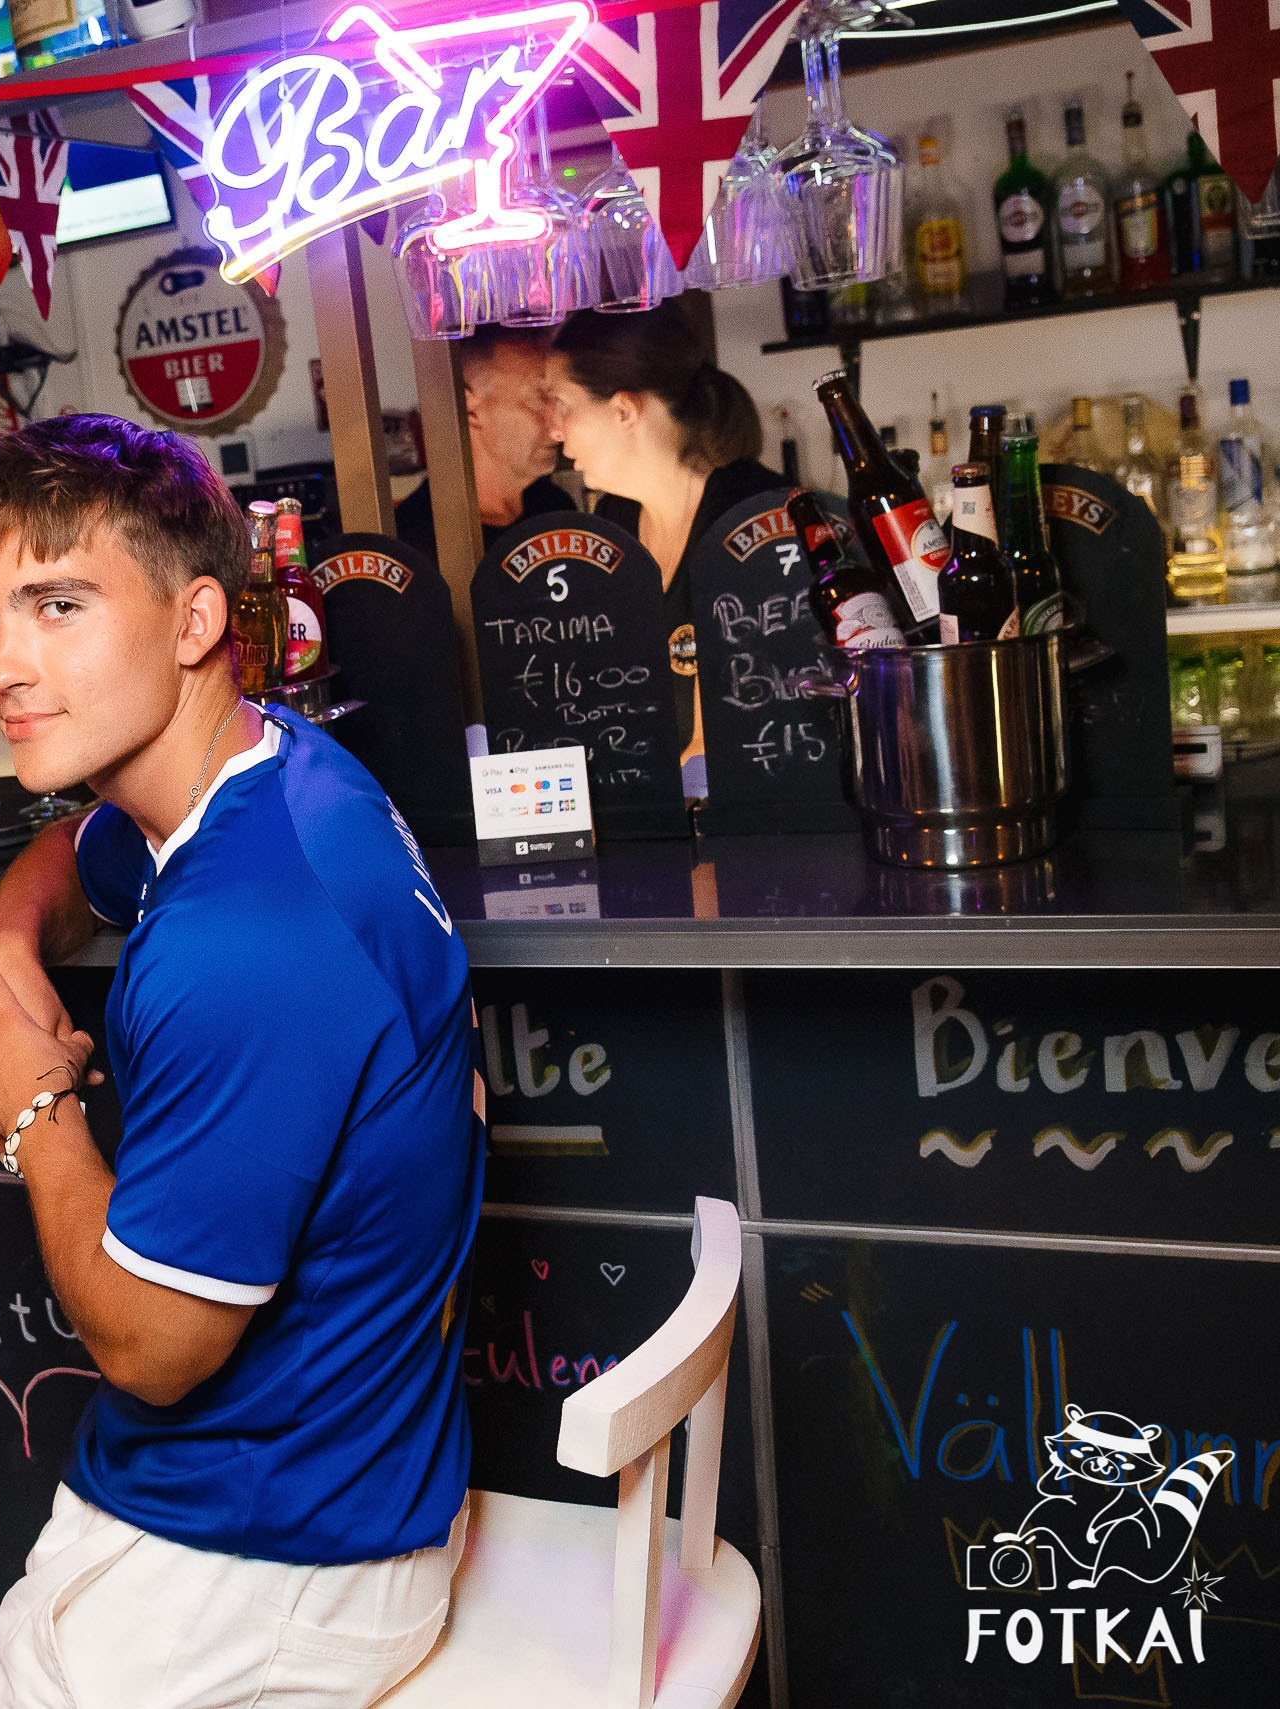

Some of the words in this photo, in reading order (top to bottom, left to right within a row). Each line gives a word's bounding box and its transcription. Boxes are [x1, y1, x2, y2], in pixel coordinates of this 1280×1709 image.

[208, 45, 535, 243] Bar
[135, 307, 249, 349] AMSTEL
[163, 352, 225, 380] BIER
[510, 529, 617, 574] BAILEYS
[775, 543, 802, 577] 7
[546, 563, 569, 603] 5
[484, 613, 617, 645] TARIMA
[485, 787, 502, 796] VISA
[529, 842, 554, 852] sumup
